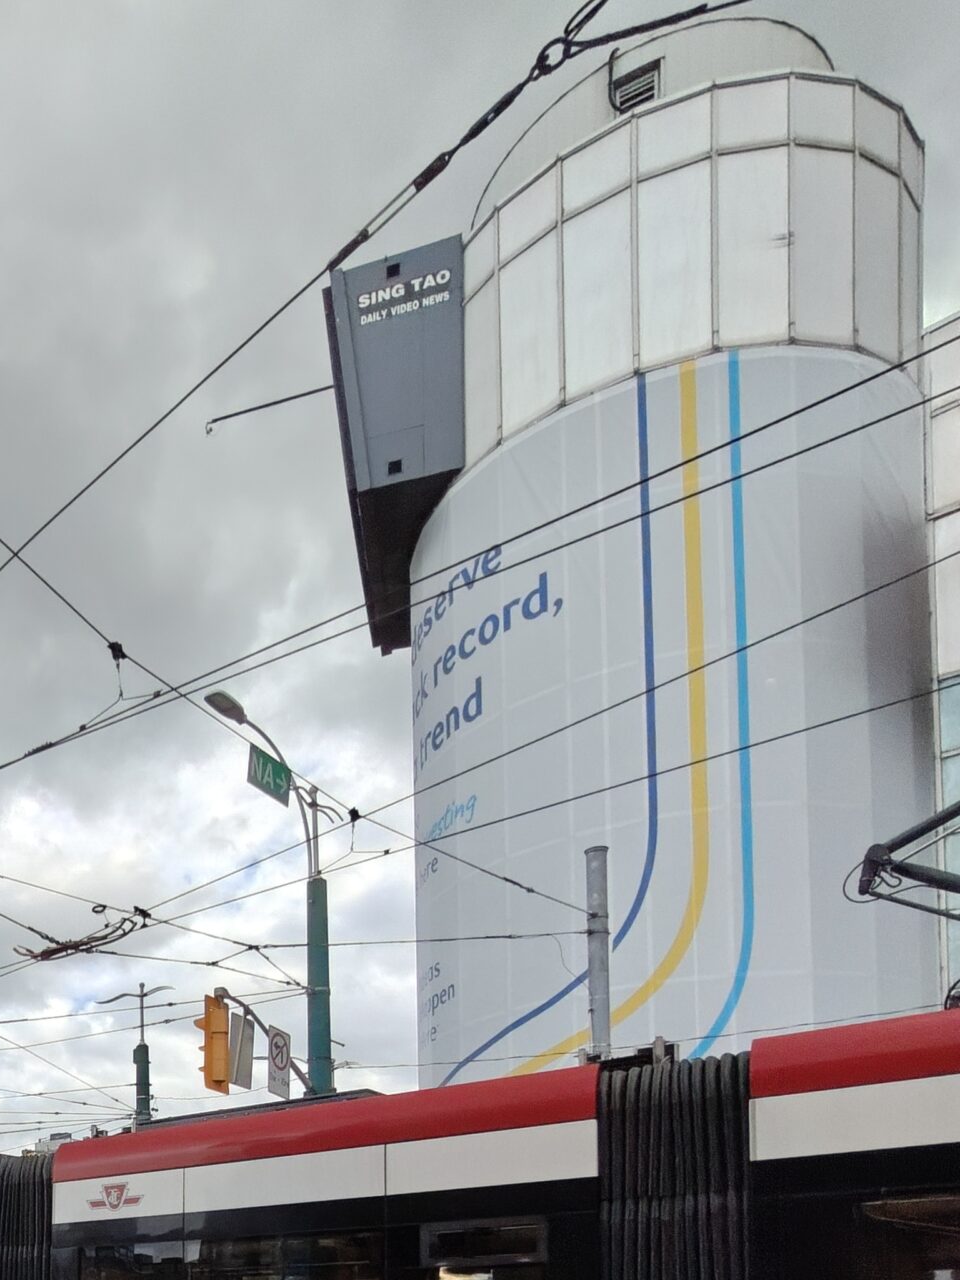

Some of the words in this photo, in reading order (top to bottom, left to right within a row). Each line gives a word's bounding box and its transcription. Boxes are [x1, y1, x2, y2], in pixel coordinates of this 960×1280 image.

[358, 283, 406, 308] SING
[411, 269, 451, 292] TAO
[360, 308, 388, 325] DAILY
[390, 299, 419, 316] VIDEO
[422, 290, 450, 307] NEWS
[433, 571, 563, 688] record,
[419, 676, 483, 770] trend
[251, 752, 274, 790] NA
